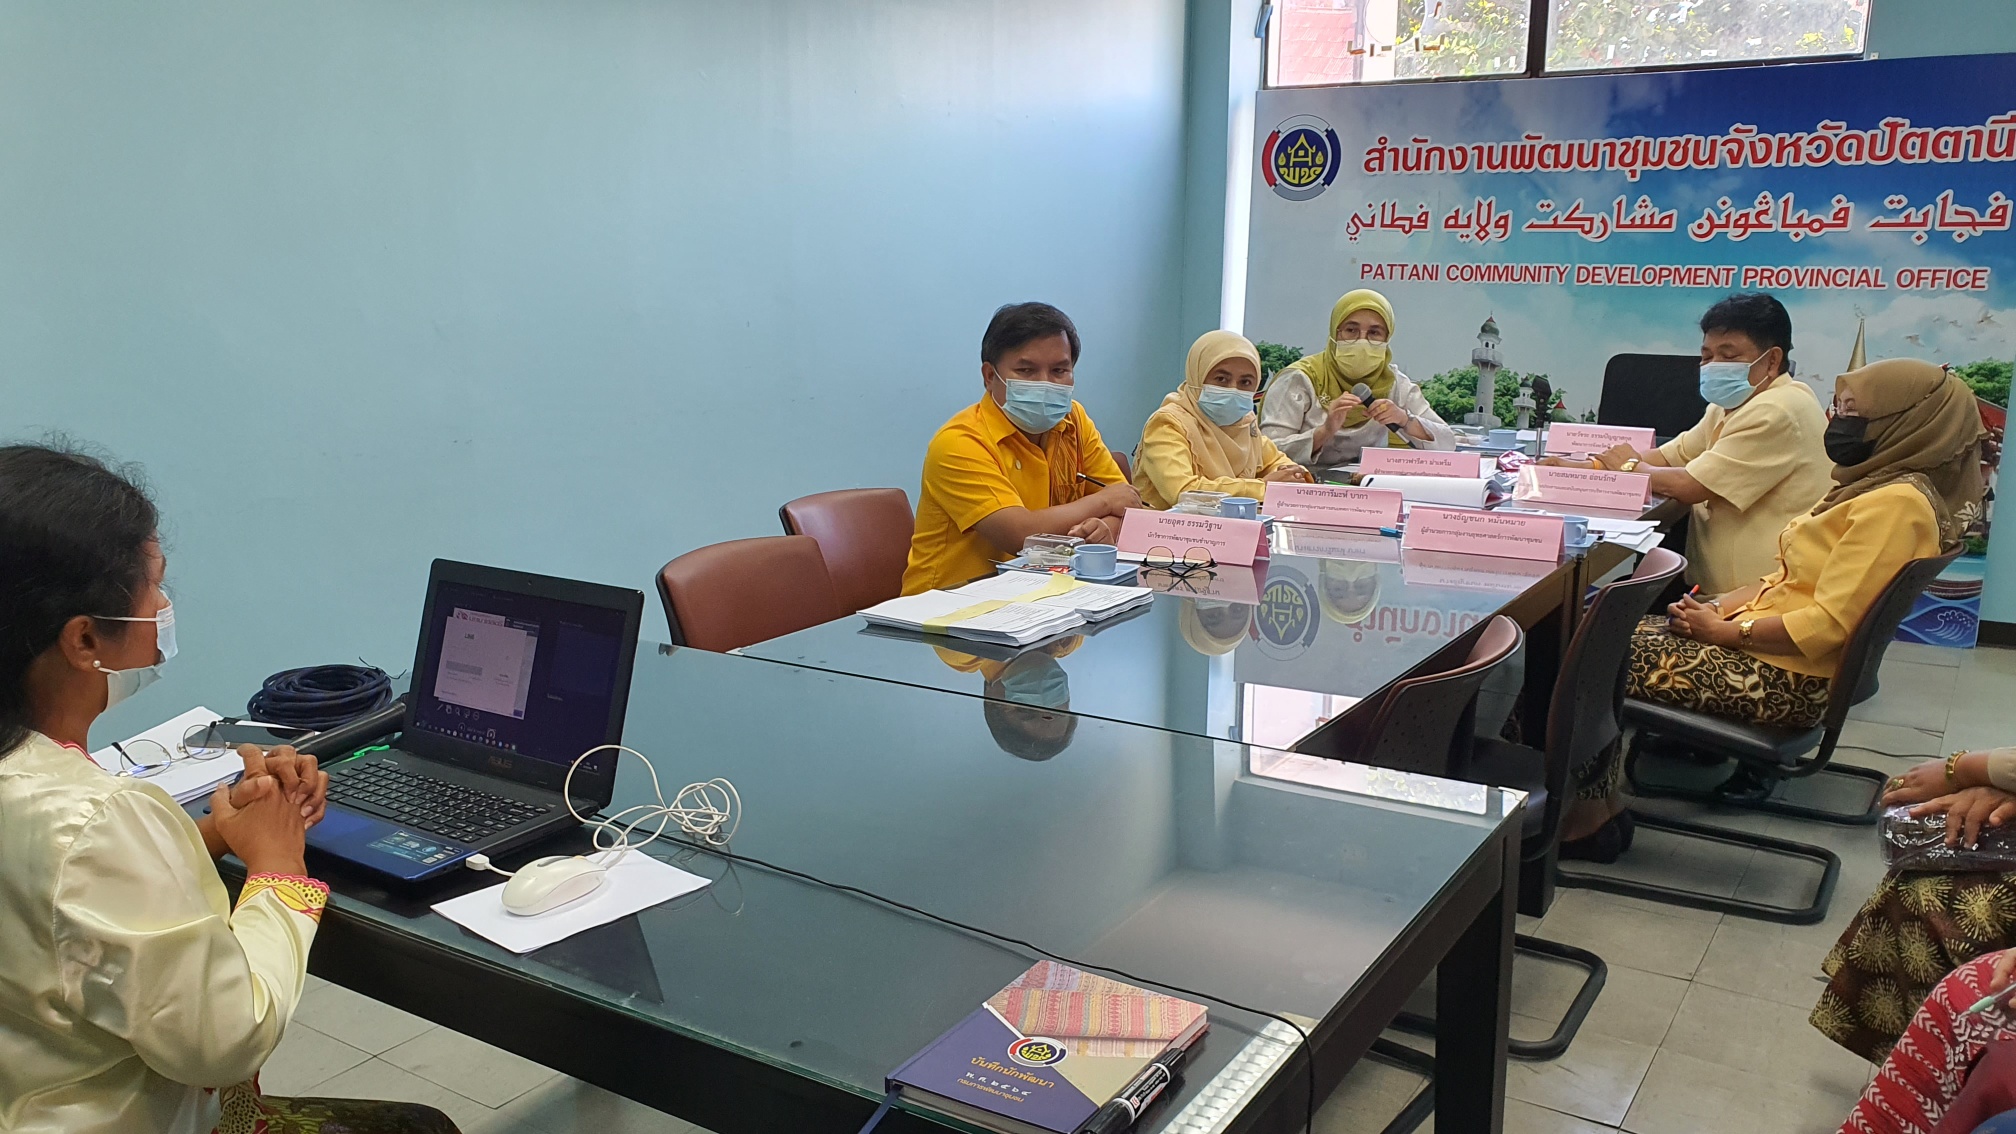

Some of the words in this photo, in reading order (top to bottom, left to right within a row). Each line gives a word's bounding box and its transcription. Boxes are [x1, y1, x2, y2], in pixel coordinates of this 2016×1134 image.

[1362, 112, 2016, 179] สำนักงานพัฒนาชุมชนจังหวัดปัตตานี
[1360, 263, 1440, 281] PATTANI
[1446, 264, 1569, 283] COMMUNITY
[1575, 266, 1735, 287] DEVELOPMENT
[1742, 268, 1886, 288] PROVINCIAL
[1896, 268, 1989, 289] OFFICE
